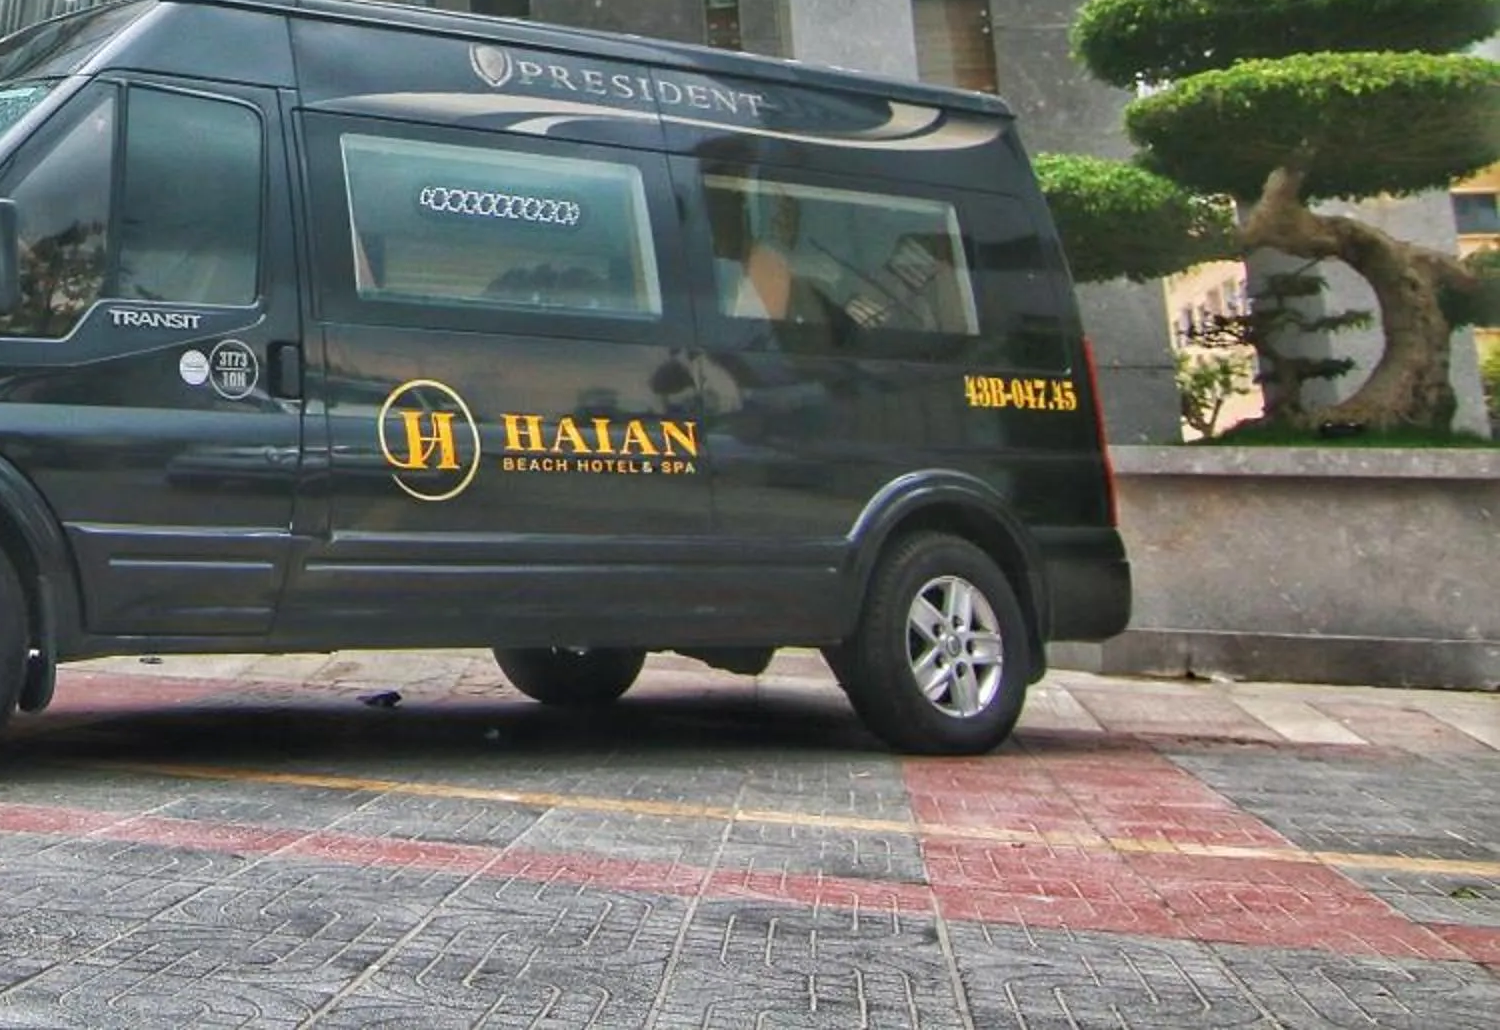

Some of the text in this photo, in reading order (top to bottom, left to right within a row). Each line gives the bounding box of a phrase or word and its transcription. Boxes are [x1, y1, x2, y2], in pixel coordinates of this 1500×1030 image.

[517, 60, 763, 118] PRESIDENT
[108, 308, 203, 330] TRANSIT
[964, 375, 1078, 411] 43B-047.45
[501, 413, 698, 457] HAIAN
[503, 457, 568, 472] BEACH
[578, 458, 638, 474] HOTEL
[660, 460, 696, 475] SPA
